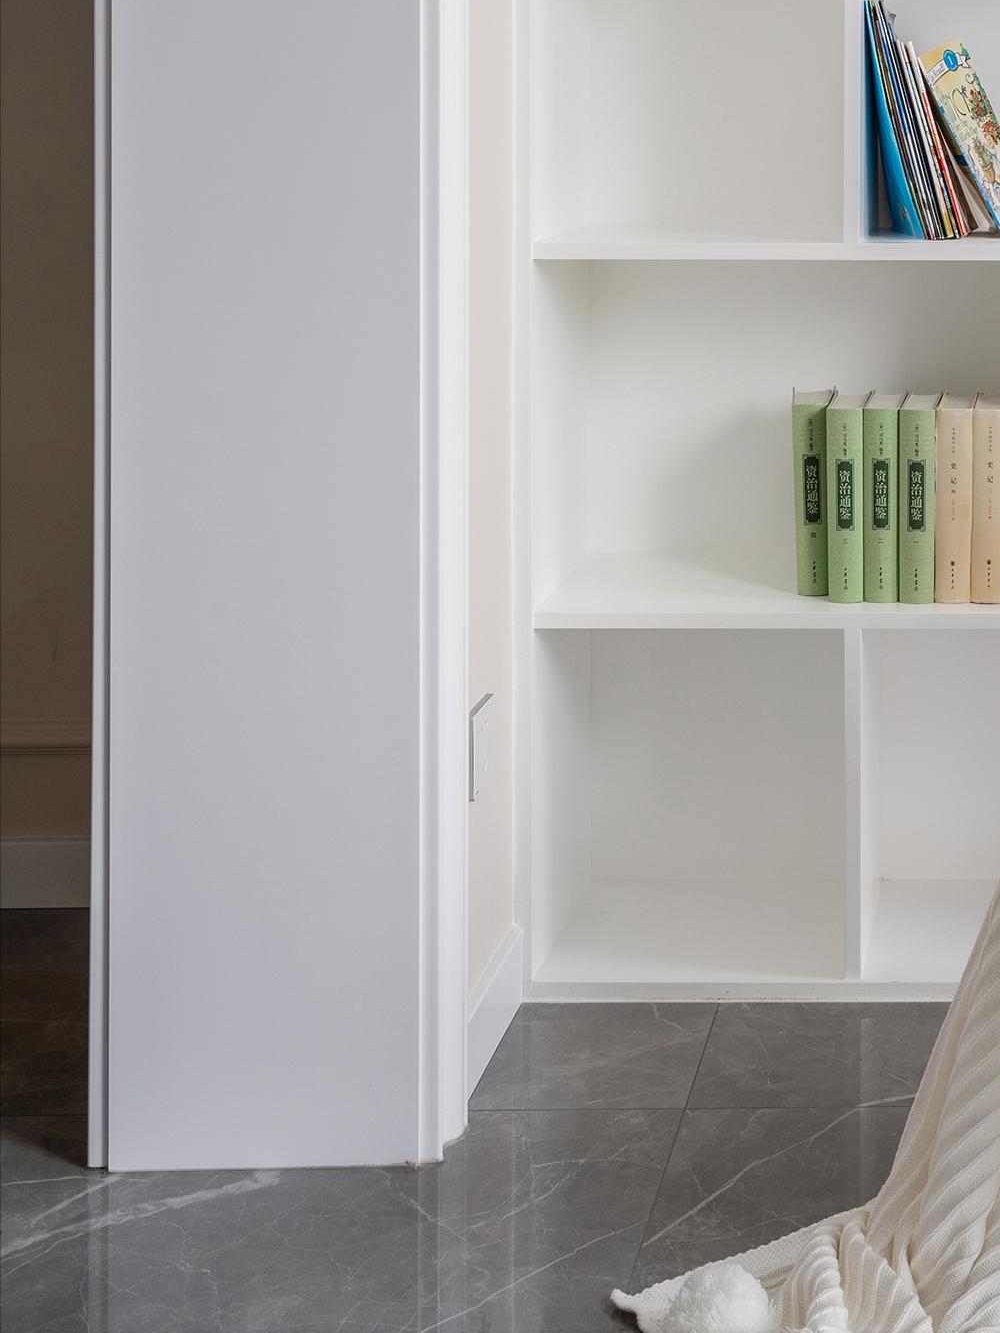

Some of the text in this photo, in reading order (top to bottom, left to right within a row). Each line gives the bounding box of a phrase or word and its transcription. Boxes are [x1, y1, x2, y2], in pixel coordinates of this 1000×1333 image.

[947, 56, 955, 66] 1
[806, 465, 818, 514] 资治通鉴
[839, 470, 851, 520] 资治通鉴
[875, 469, 887, 519] 资治通鉴
[911, 471, 922, 521] 资治通鉴
[950, 462, 957, 484] 史记
[987, 461, 994, 483] 史记
